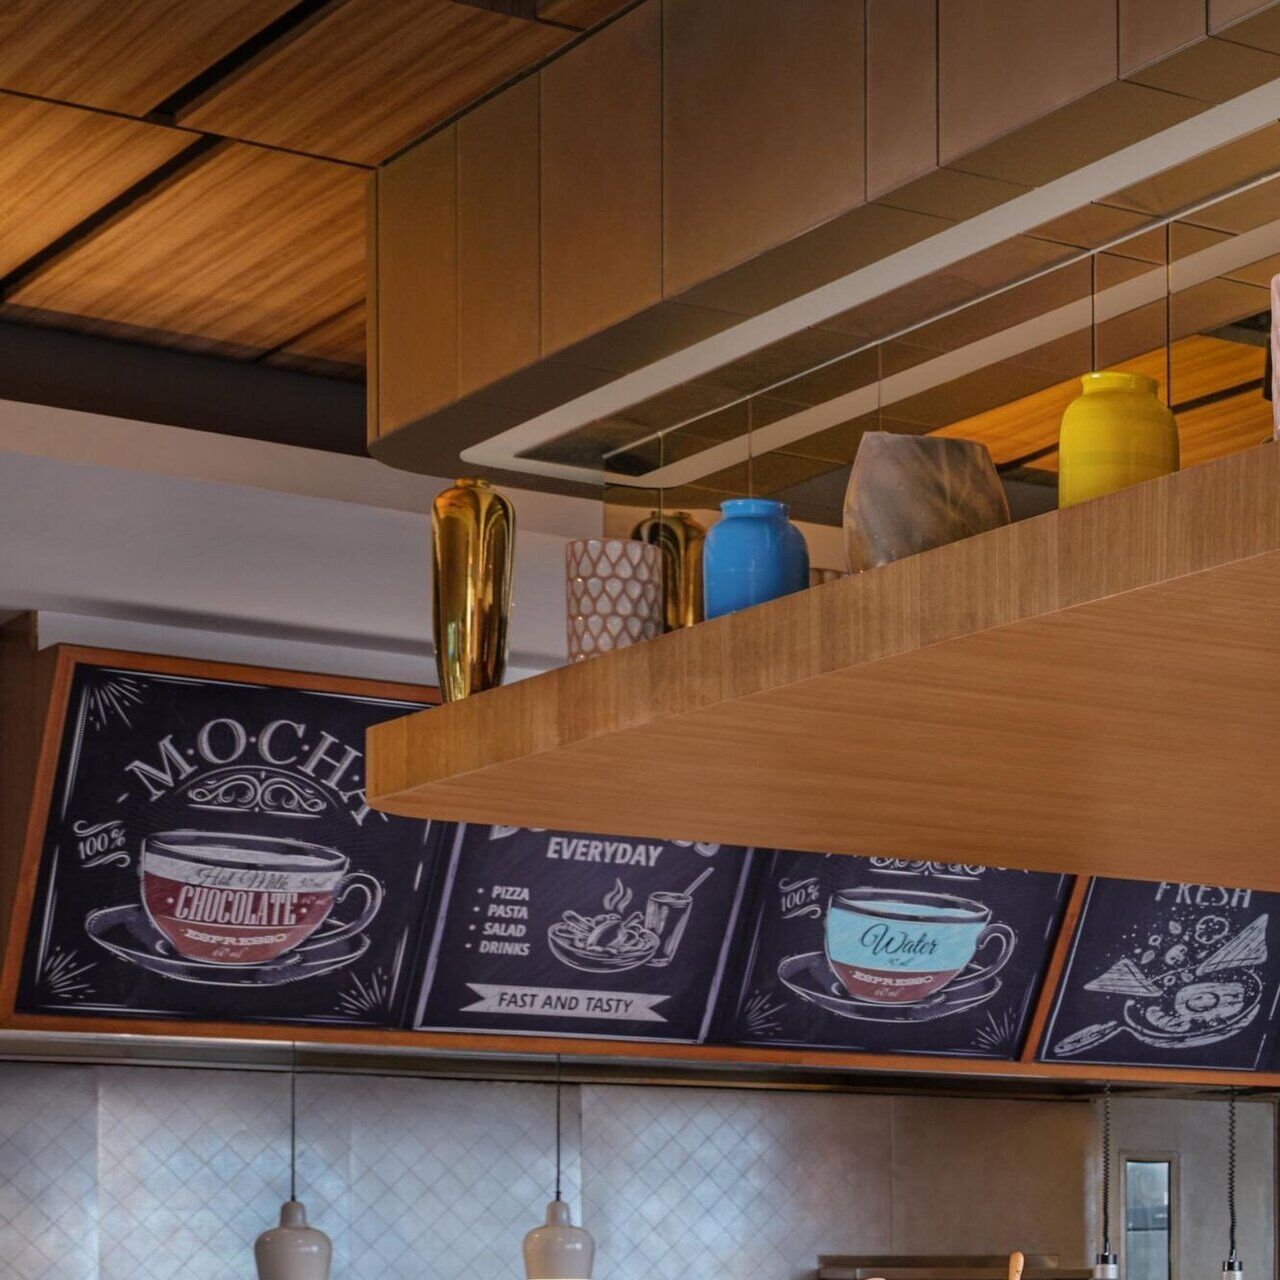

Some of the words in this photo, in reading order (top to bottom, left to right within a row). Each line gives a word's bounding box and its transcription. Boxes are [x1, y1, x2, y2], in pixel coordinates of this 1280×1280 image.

[78, 828, 126, 860] 100%
[546, 836, 664, 867] EVERYDAY
[492, 885, 530, 901] PIZZA
[780, 885, 820, 912] 100%
[174, 884, 298, 925] CHOCOLATE
[487, 904, 529, 920] PASTA
[183, 929, 290, 946] ESPRESSO
[482, 922, 527, 937] SALAD
[860, 923, 938, 955] Water
[479, 940, 531, 956] DRINKS
[852, 970, 936, 986] ESPRESSO
[497, 992, 539, 1009] FAST
[541, 995, 579, 1011] AND
[585, 996, 634, 1014] TASTY
